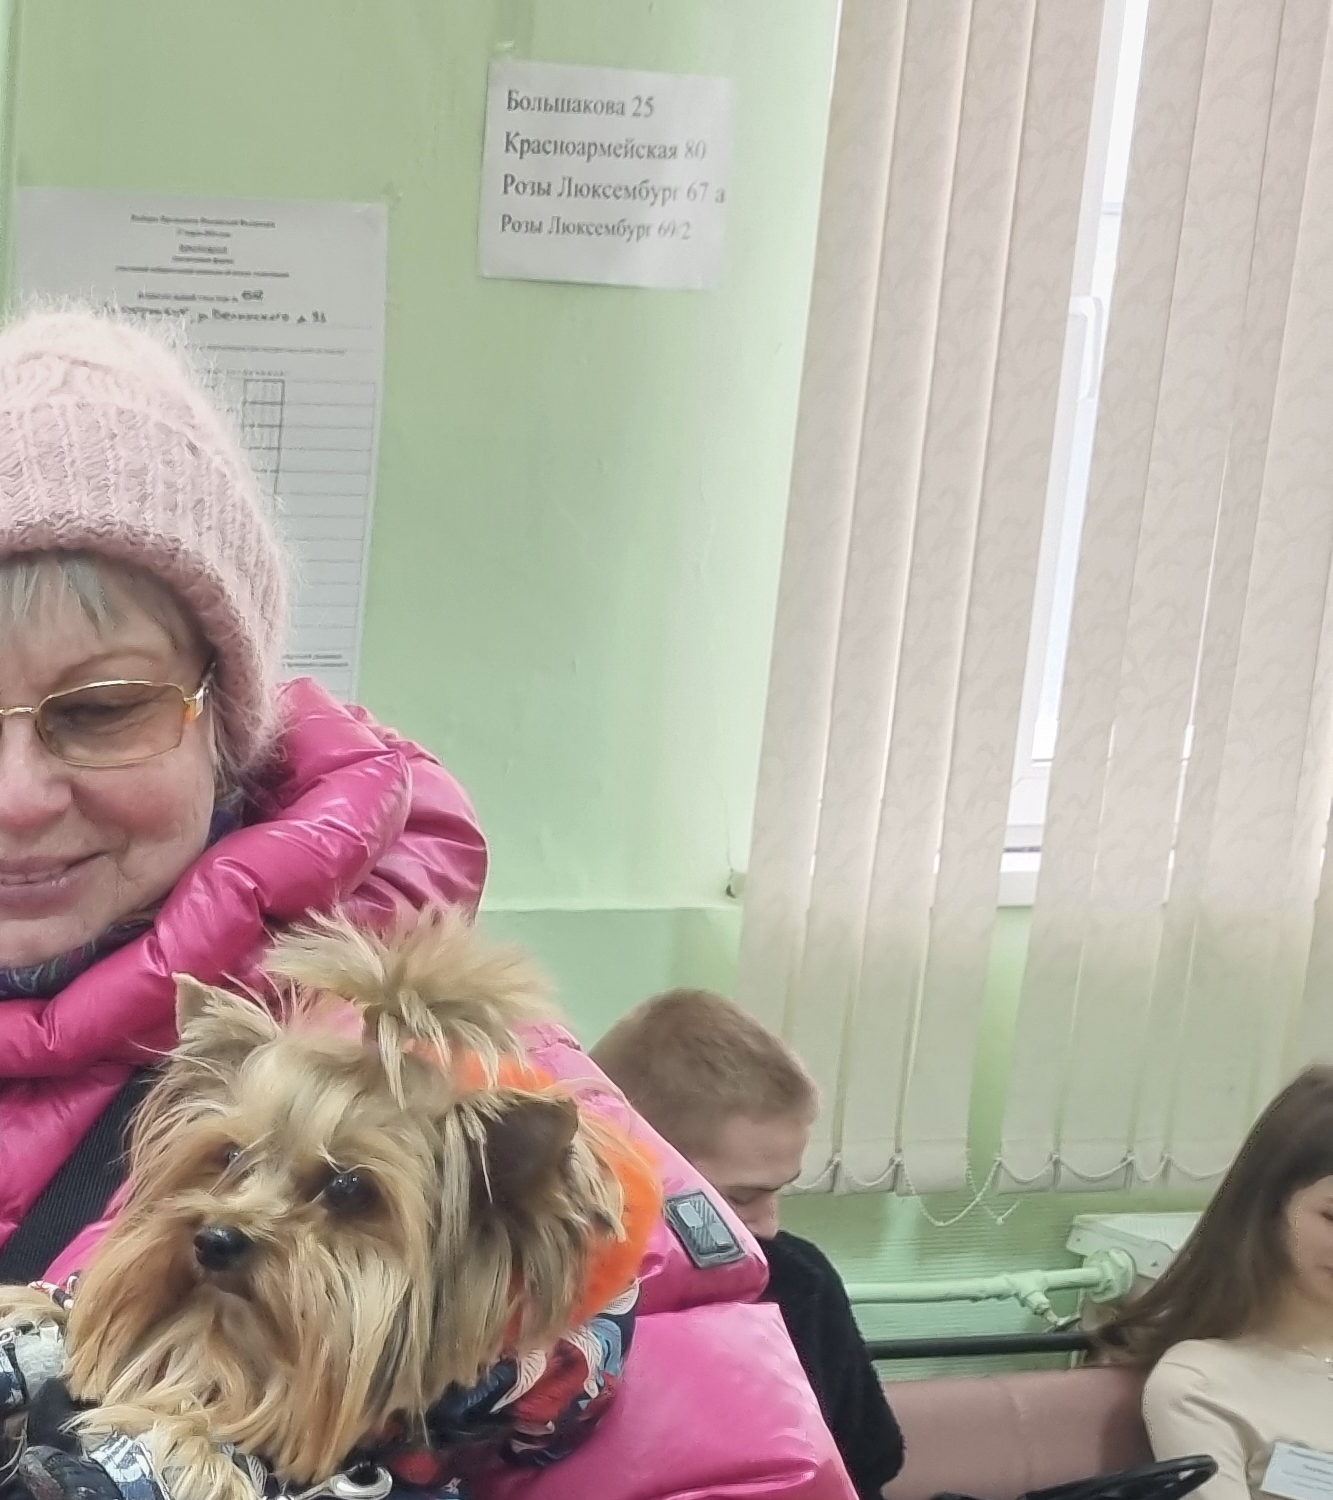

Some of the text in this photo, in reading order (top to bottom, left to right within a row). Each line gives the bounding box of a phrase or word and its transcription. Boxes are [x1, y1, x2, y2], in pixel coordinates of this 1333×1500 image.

[506, 88, 655, 118] Большакова 25
[504, 131, 707, 163] Красноармейская 80
[502, 173, 726, 207] Розы Люксембург 67 а
[501, 214, 543, 233] Розы
[547, 216, 653, 243] Люксембург
